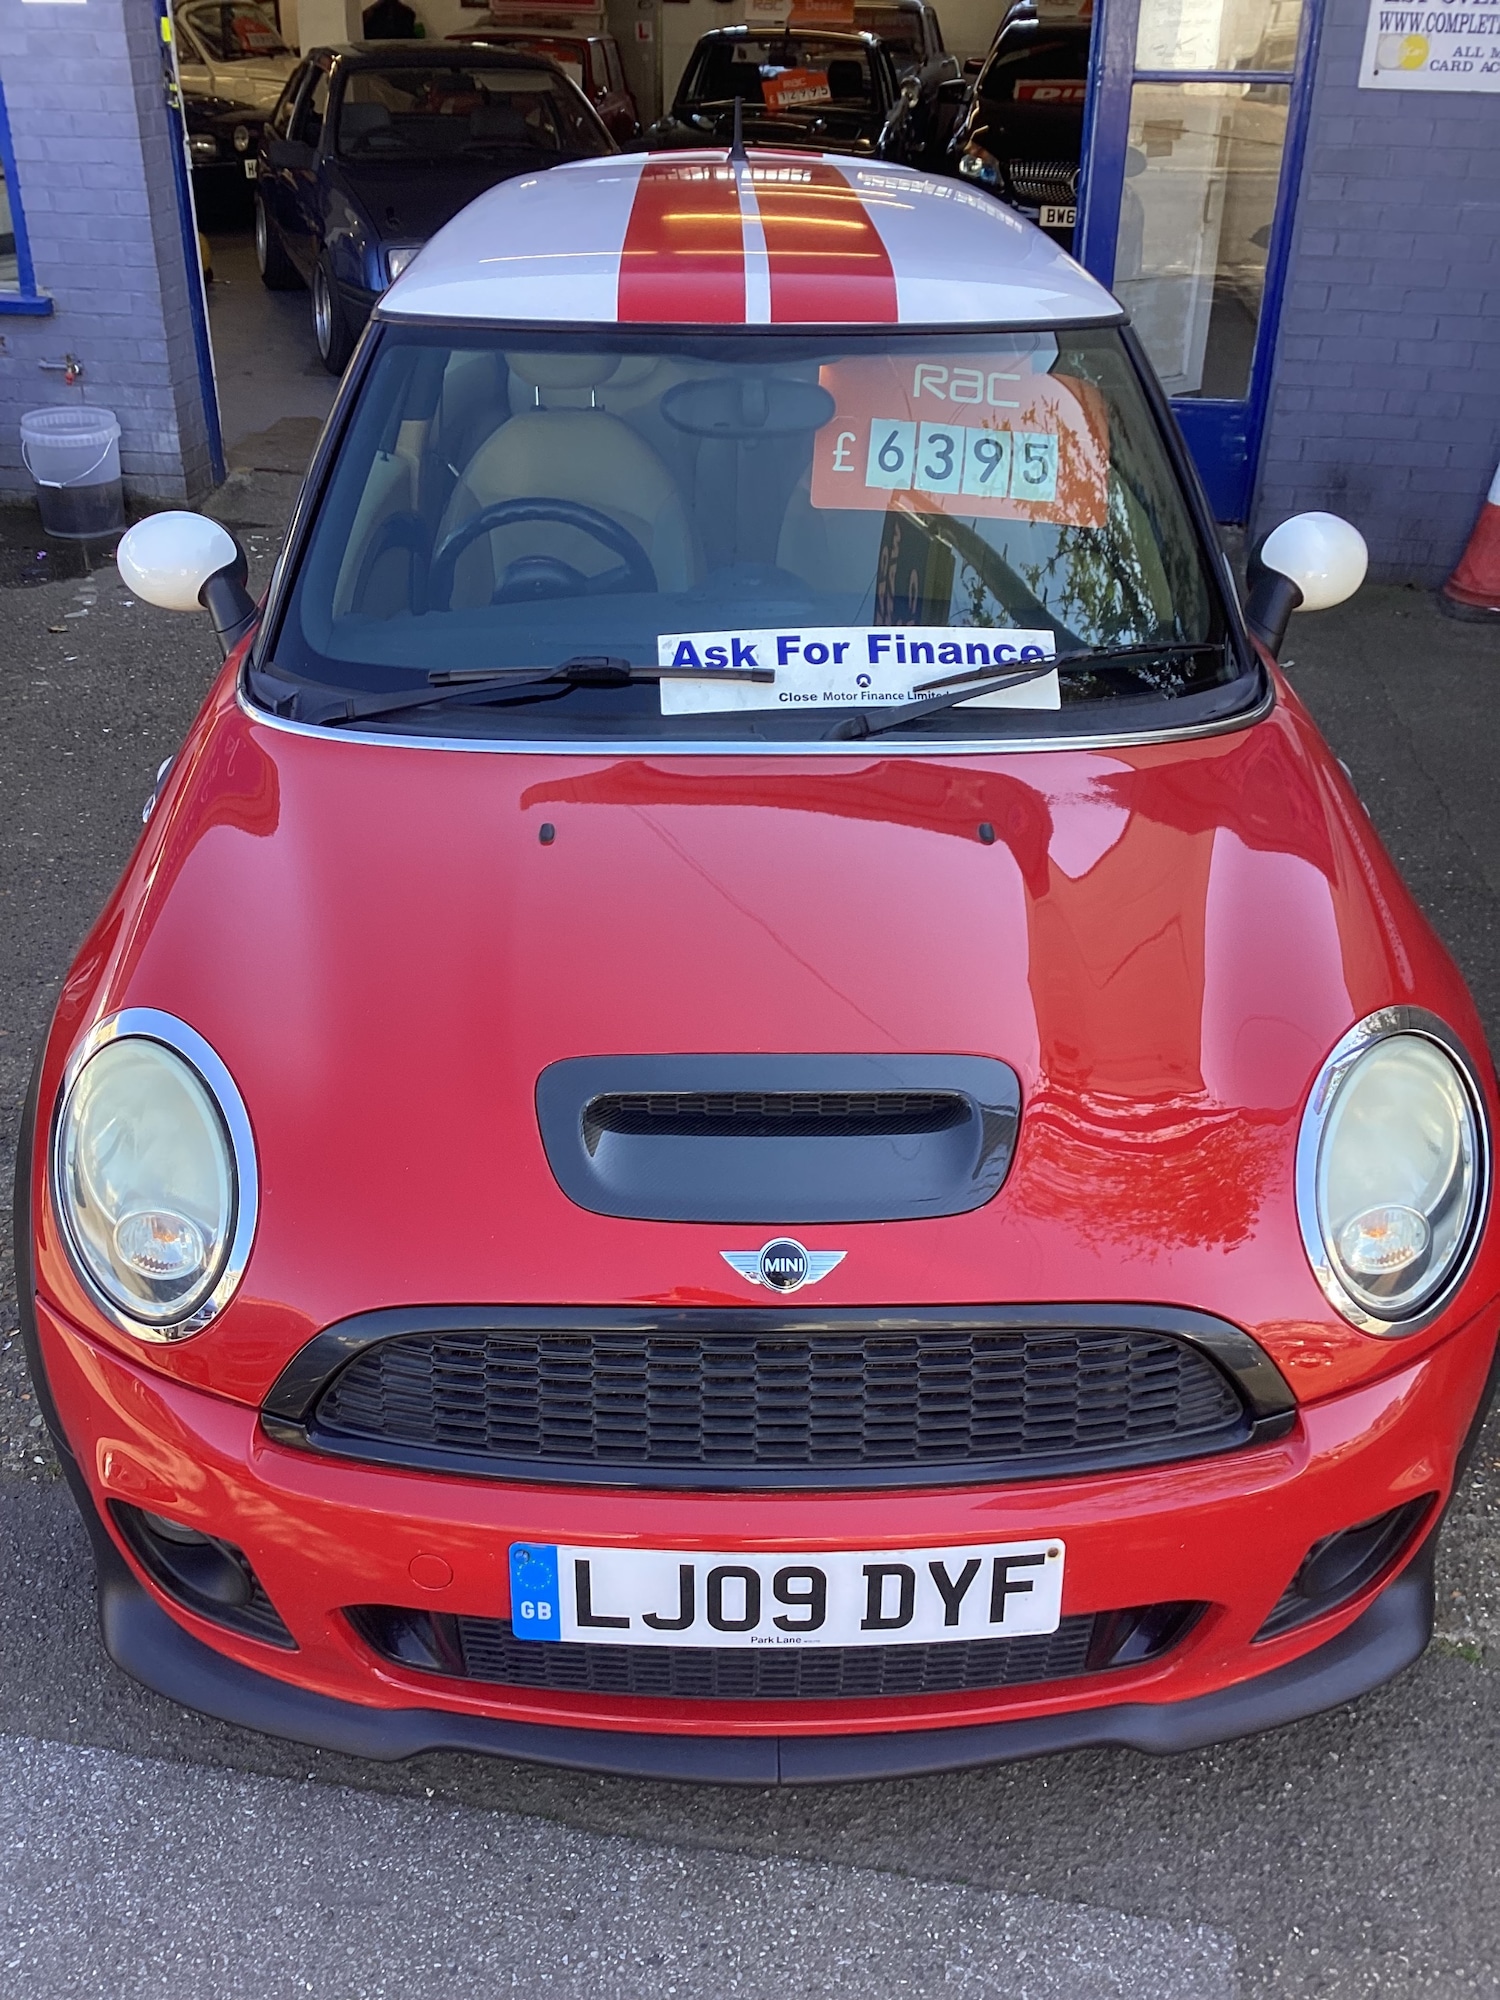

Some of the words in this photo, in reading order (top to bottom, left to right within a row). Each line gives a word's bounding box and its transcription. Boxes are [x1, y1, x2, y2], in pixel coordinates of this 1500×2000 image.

[1380, 11, 1500, 35] WWW.COMPLET
[1452, 46, 1485, 58] ALL
[1430, 60, 1474, 72] CARD
[671, 637, 760, 668] Ask
[776, 635, 850, 666] For
[867, 634, 1044, 665] Finance
[778, 692, 818, 702] Close
[823, 692, 858, 701] Motor
[861, 691, 905, 701] Finance
[764, 1257, 803, 1272] MINI
[574, 1558, 827, 1632] LJ09
[860, 1553, 1046, 1631] DYF
[520, 1600, 552, 1620] GB
[750, 1636, 774, 1644] Park
[776, 1636, 802, 1644] Lane
